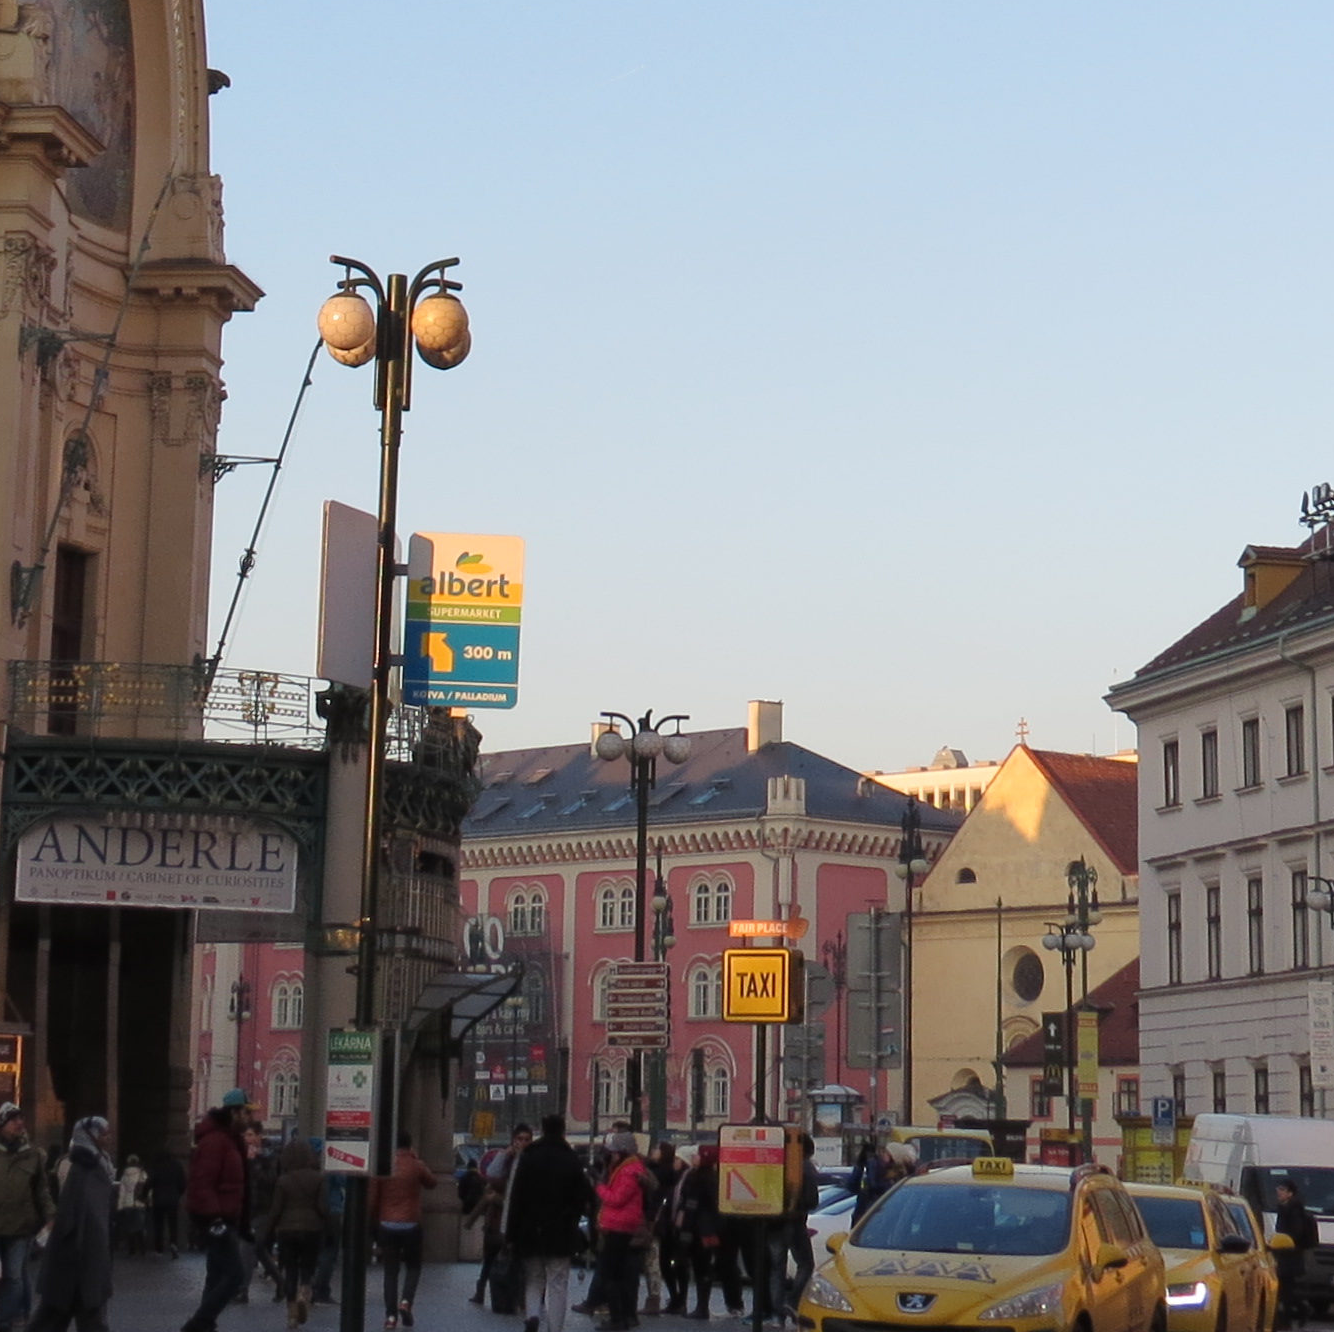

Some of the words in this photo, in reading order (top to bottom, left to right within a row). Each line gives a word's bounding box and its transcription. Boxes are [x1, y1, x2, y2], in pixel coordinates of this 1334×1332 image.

[420, 571, 510, 598] albert
[427, 606, 501, 619] SUPERMARKET
[463, 645, 493, 660] 300
[497, 650, 512, 661] m
[454, 691, 507, 702] PALLADIUM
[30, 824, 285, 873] ANDERLE
[30, 867, 117, 882] PANOPTIKUM
[127, 871, 184, 885] CABINET
[185, 874, 204, 885] OF
[206, 876, 285, 889] CURIOSITIES
[733, 923, 755, 933] FAIR
[757, 923, 788, 933] PLACE
[736, 972, 776, 998] TAXI
[1158, 1100, 1169, 1118] P
[979, 1160, 1006, 1171] TAXI
